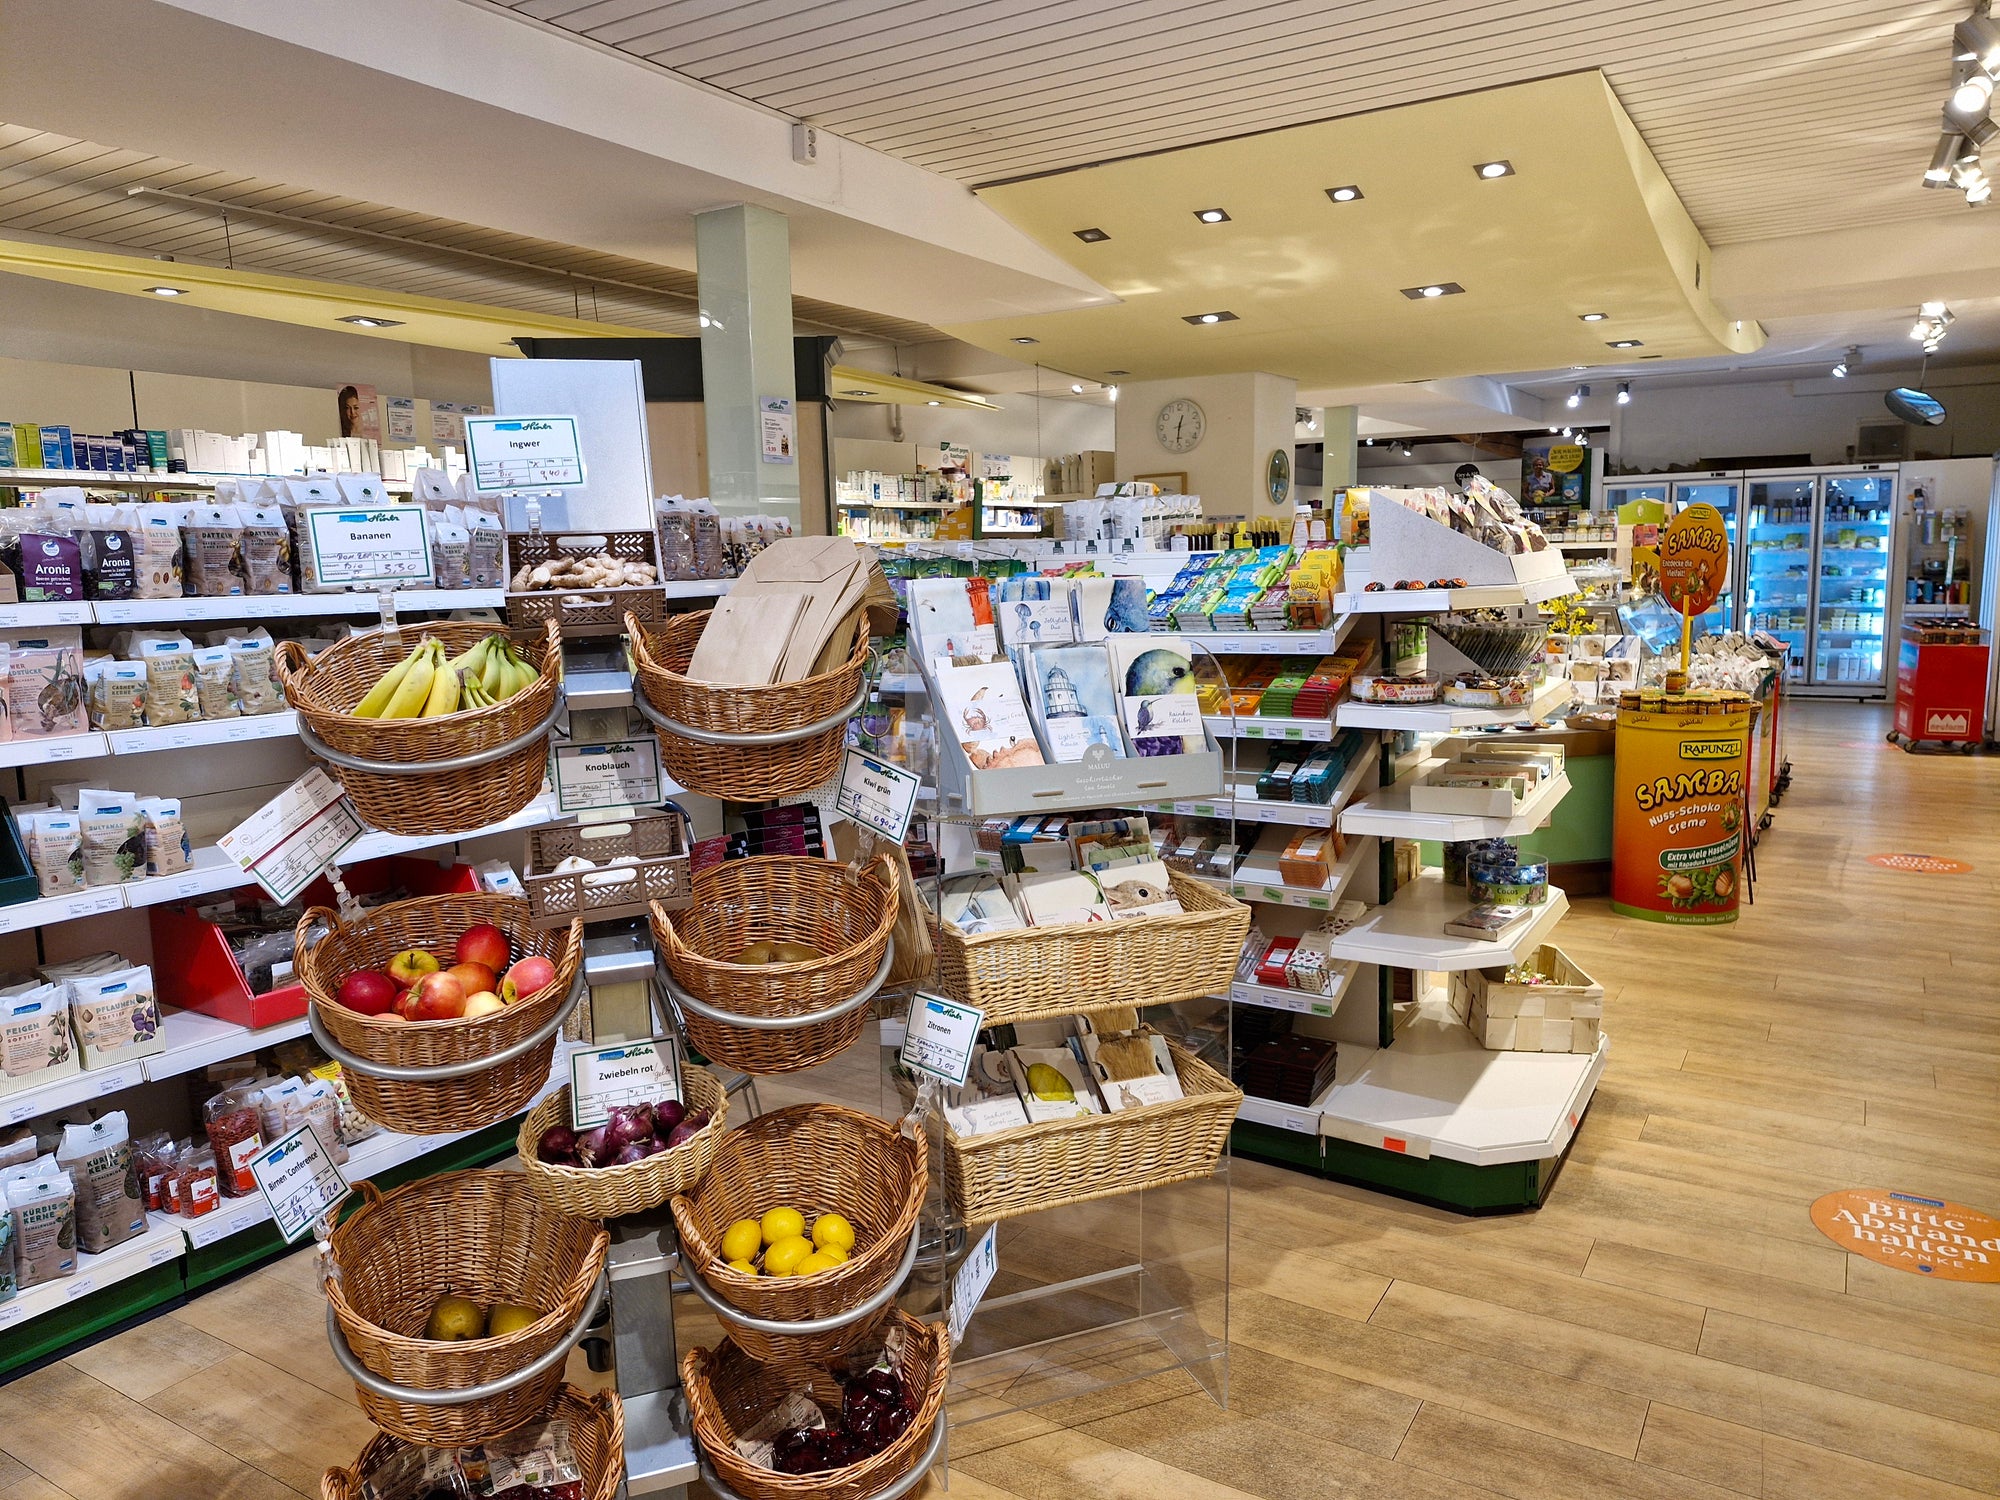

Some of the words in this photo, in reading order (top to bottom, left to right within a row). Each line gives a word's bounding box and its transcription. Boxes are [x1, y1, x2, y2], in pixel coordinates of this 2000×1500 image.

[510, 440, 540, 450] Ingwer
[350, 532, 392, 541] Bananen
[1668, 526, 1722, 556] SAMBA
[36, 564, 70, 574] Aronia
[102, 557, 130, 567] Aronia
[384, 562, 416, 574] 3,30
[1682, 742, 1740, 756] RAPUNZEL
[586, 761, 630, 772] Knoblauch
[864, 777, 877, 788] Kiwi
[877, 784, 891, 796] grün
[1636, 770, 1741, 812] SAMBA
[1648, 802, 1721, 828] Nuss-Schoko
[88, 823, 124, 831] SULTANAS
[1668, 818, 1707, 835] Creme
[1667, 852, 1688, 861] Extra
[1689, 850, 1707, 859] viele
[96, 999, 136, 1014] PFLAUMEN
[6, 1023, 40, 1036] FEIGEN
[928, 1020, 951, 1035] Zitronen
[8, 1033, 39, 1043] SOFTIES
[599, 1067, 639, 1081] Zwiebeln
[641, 1065, 654, 1074] rot
[268, 1174, 288, 1192] Birnen
[320, 1182, 338, 1201] 5,20
[23, 1203, 58, 1218] KÜRBIS
[24, 1212, 55, 1224] KERNE
[1867, 1201, 1966, 1231] Bitte
[1832, 1208, 2000, 1252] Abstand
[1852, 1225, 1990, 1264] halten
